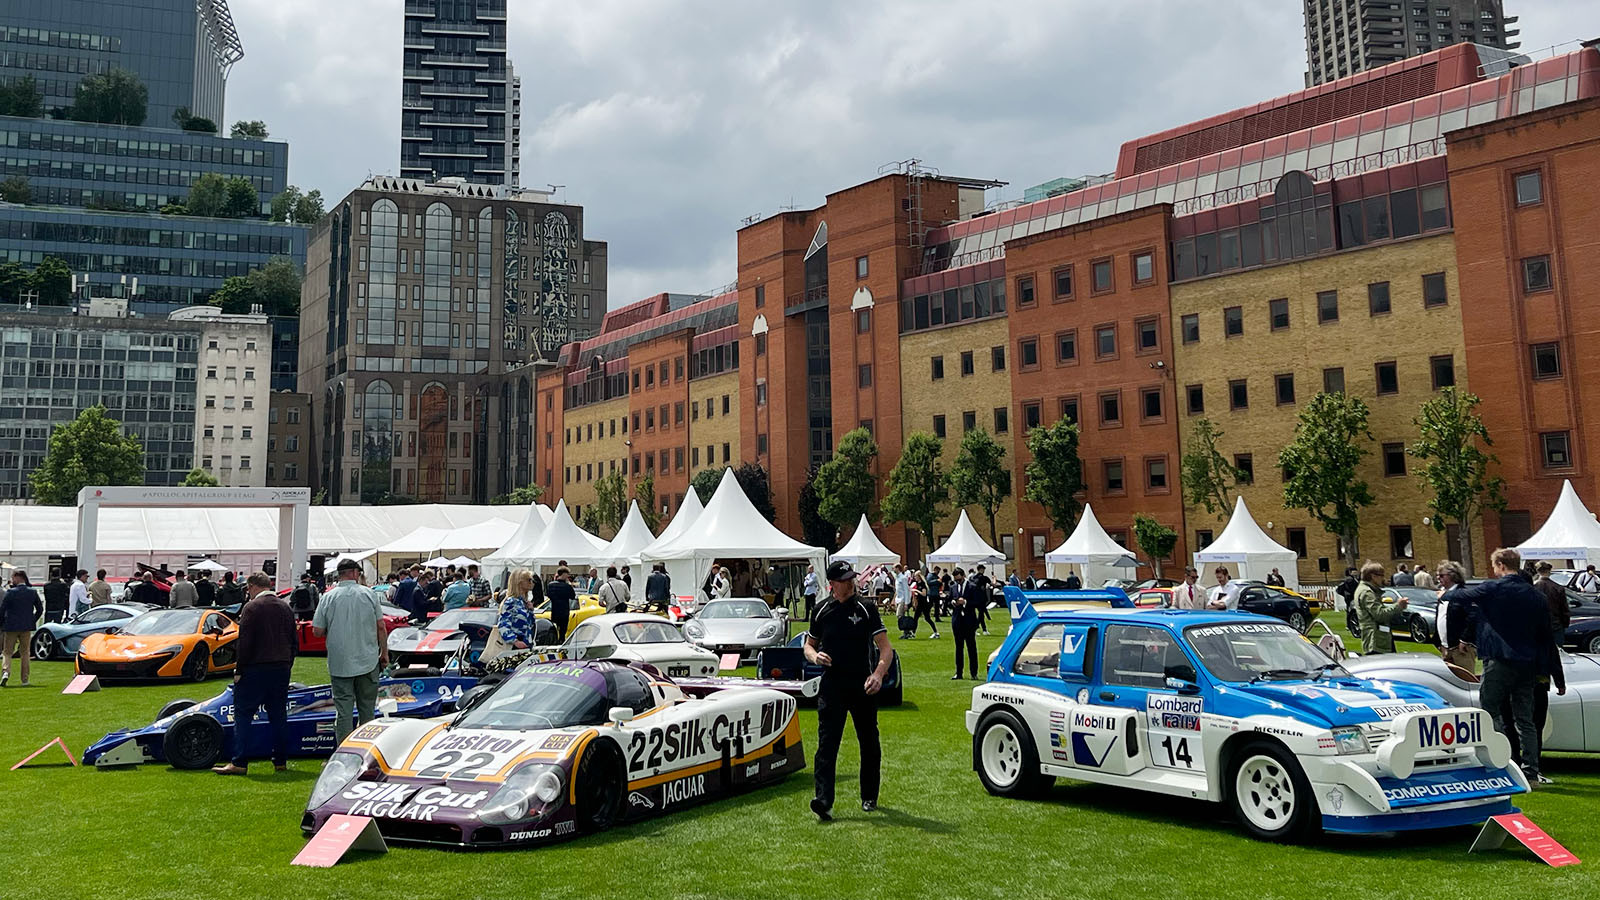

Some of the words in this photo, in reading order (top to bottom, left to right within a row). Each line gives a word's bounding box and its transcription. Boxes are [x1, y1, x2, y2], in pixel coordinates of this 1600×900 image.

[1191, 626, 1230, 638] FIRST
[1229, 625, 1245, 634] IN
[517, 665, 584, 678] JAGUAR
[438, 685, 464, 700] 24
[981, 692, 1025, 705] MICHELIN
[1148, 696, 1202, 714] Lombard
[1075, 713, 1104, 729] Mobil
[1107, 717, 1115, 730] 1
[1162, 713, 1200, 730] rally
[1418, 712, 1482, 748] Mobil
[358, 731, 377, 739] CUT
[1253, 726, 1304, 738] MICHELIN
[431, 733, 526, 754] Castrol
[544, 741, 566, 749] CUT
[629, 727, 664, 773] 22
[663, 719, 707, 762] Silk
[711, 710, 752, 752] Cut
[1162, 735, 1193, 768] 14
[417, 751, 495, 779] 22
[343, 782, 420, 803] Silk
[414, 786, 488, 809] Cut
[662, 774, 705, 810] JAGUAR
[1382, 776, 1513, 800] COMPUTERVISION
[346, 800, 439, 821] JAGUAR
[510, 828, 552, 840] DUNLOP
